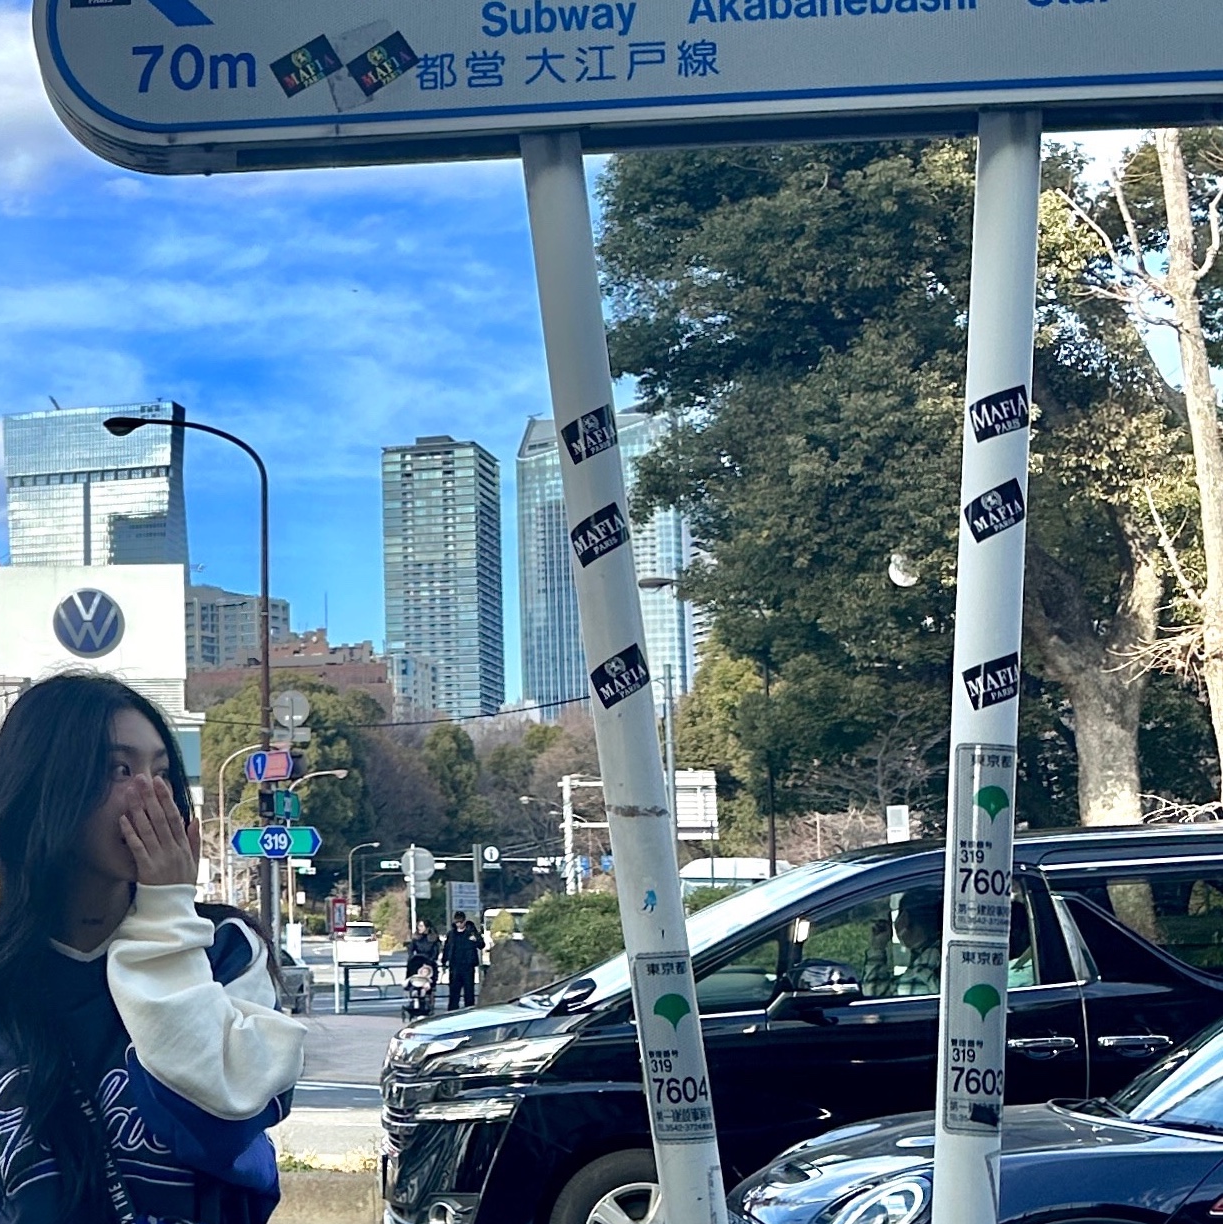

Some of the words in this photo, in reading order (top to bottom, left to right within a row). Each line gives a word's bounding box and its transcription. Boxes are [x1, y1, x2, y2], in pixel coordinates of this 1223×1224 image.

[481, 0, 637, 37] Subway
[131, 43, 256, 93] 70m
[361, 50, 412, 88] MAFIA
[971, 392, 1028, 432] MAFIA
[994, 417, 1021, 435] PARIS
[571, 425, 616, 456] MAFIA
[973, 499, 1023, 533] MAFIA
[993, 517, 1016, 532] PARIS
[573, 513, 626, 557] MAFIA
[593, 537, 619, 555] PARIS
[599, 664, 647, 700] MAFIA
[966, 663, 1019, 697] MAFIA
[990, 686, 1015, 701] PARIS
[255, 756, 263, 775] 1
[263, 833, 289, 851] 319
[960, 850, 985, 864] 319
[962, 951, 1005, 966] 東京都
[646, 961, 688, 976] 東京都
[952, 1048, 976, 1063] 319
[651, 1059, 673, 1073] 319
[653, 1076, 708, 1104] 7604
